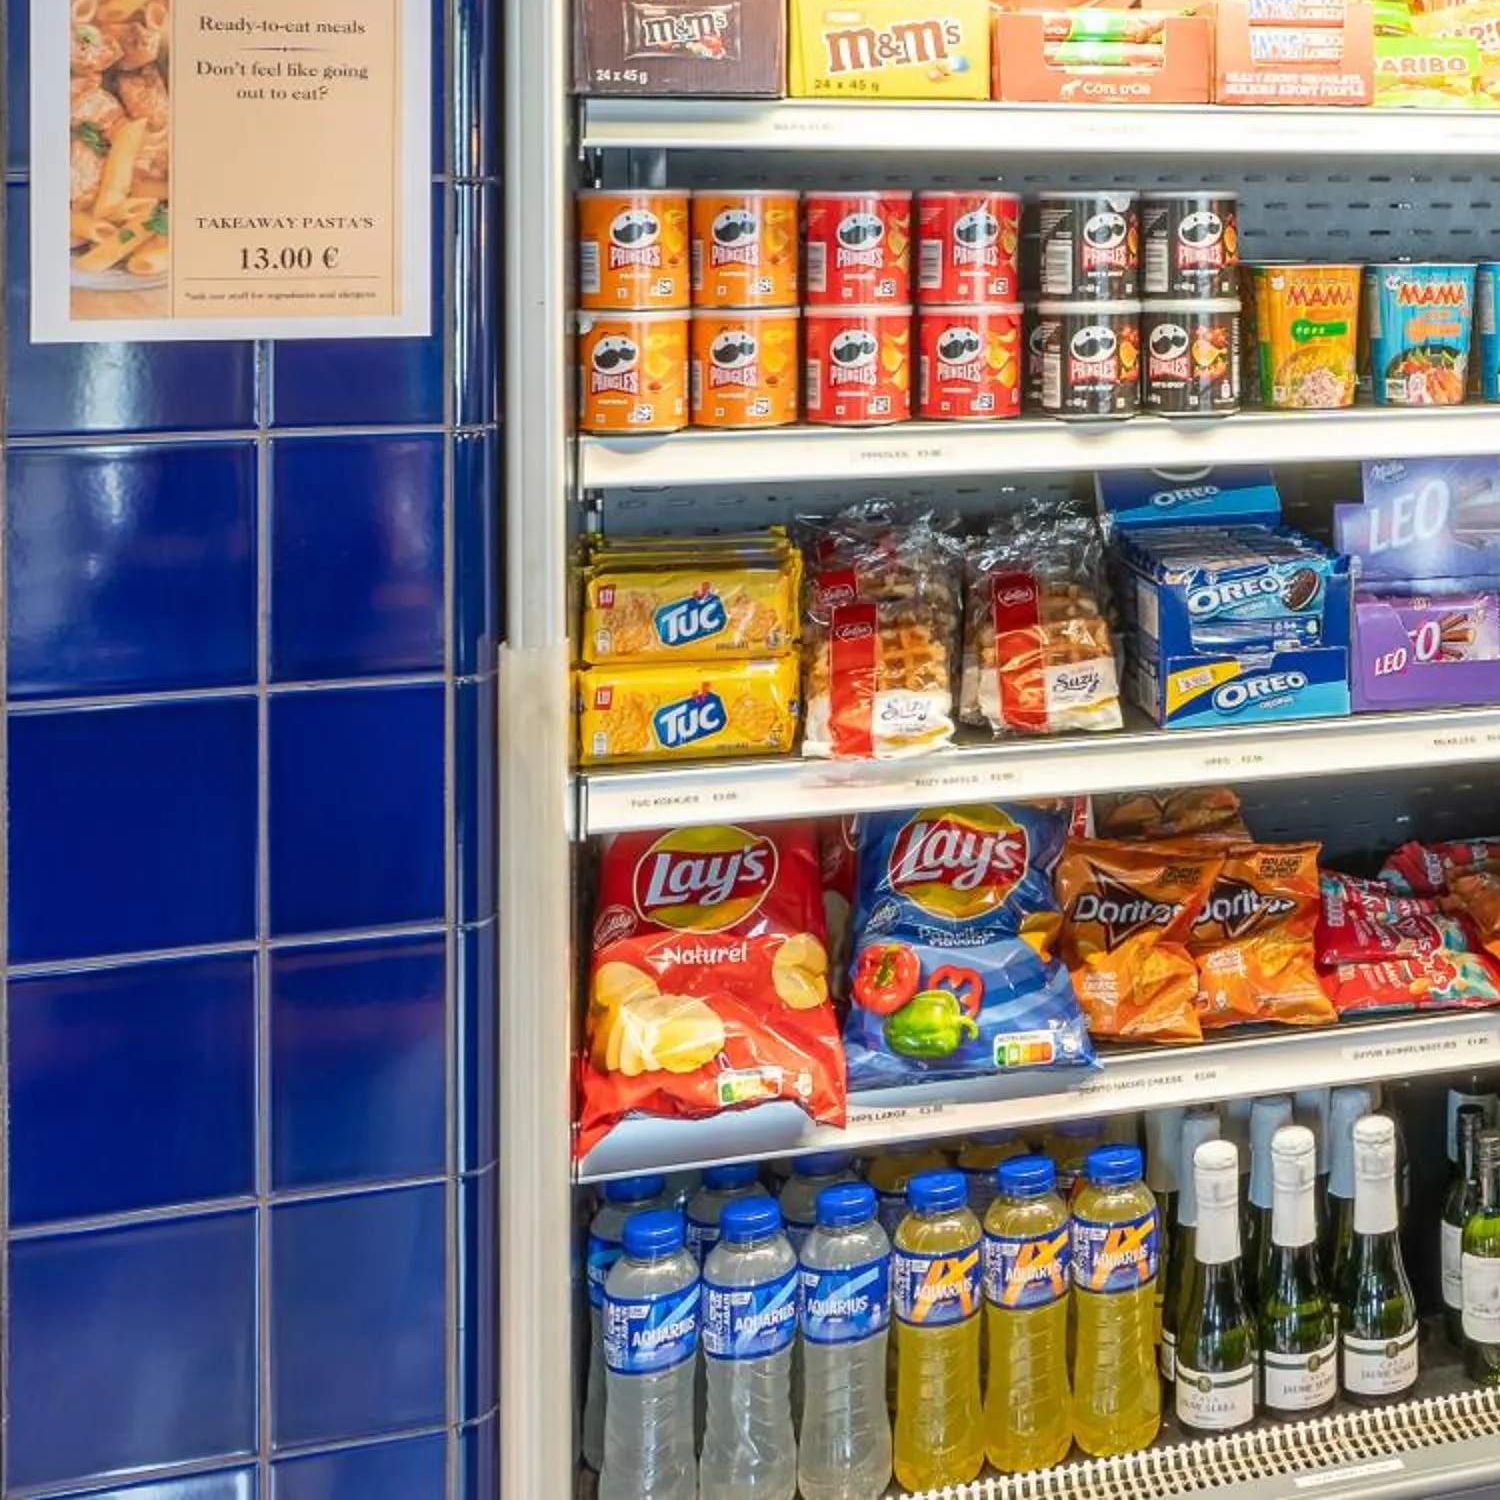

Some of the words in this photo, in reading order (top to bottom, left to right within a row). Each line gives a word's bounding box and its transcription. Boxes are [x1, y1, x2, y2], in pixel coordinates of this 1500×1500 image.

[199, 15, 311, 35] Ready-to-eat
[316, 19, 366, 35] meals
[826, 18, 961, 74] m&m's
[196, 61, 246, 78] Don't
[251, 61, 283, 78] feel
[287, 62, 319, 78] like
[323, 63, 368, 81] going
[597, 68, 612, 82] 24
[613, 71, 622, 82] x
[623, 69, 637, 82] 45
[638, 72, 648, 85] g
[1376, 56, 1467, 75] ARIBO
[236, 86, 265, 100] out
[270, 87, 287, 100] to
[291, 85, 329, 101] eat?
[814, 79, 832, 92] 24
[849, 80, 867, 92] 45
[196, 216, 299, 229] TAKEAWAY
[302, 216, 374, 229] PASTA'S
[240, 247, 312, 270] 13.00
[322, 245, 339, 269] €
[1153, 486, 1219, 508] OREO
[1369, 477, 1451, 555] LEO
[1187, 576, 1280, 615] OREO
[661, 603, 720, 643] TUC
[1374, 647, 1407, 677] LEO
[1053, 671, 1103, 693] Suzy
[1216, 673, 1306, 710] OREO
[660, 703, 720, 744] TUC
[894, 822, 1022, 891] Lay's
[644, 846, 769, 908] Lay's
[664, 943, 748, 967] Naturel
[735, 1301, 796, 1333] AQUARIUS
[807, 1295, 869, 1317] AQUARIUS
[632, 1317, 696, 1349] AQUARIUS
